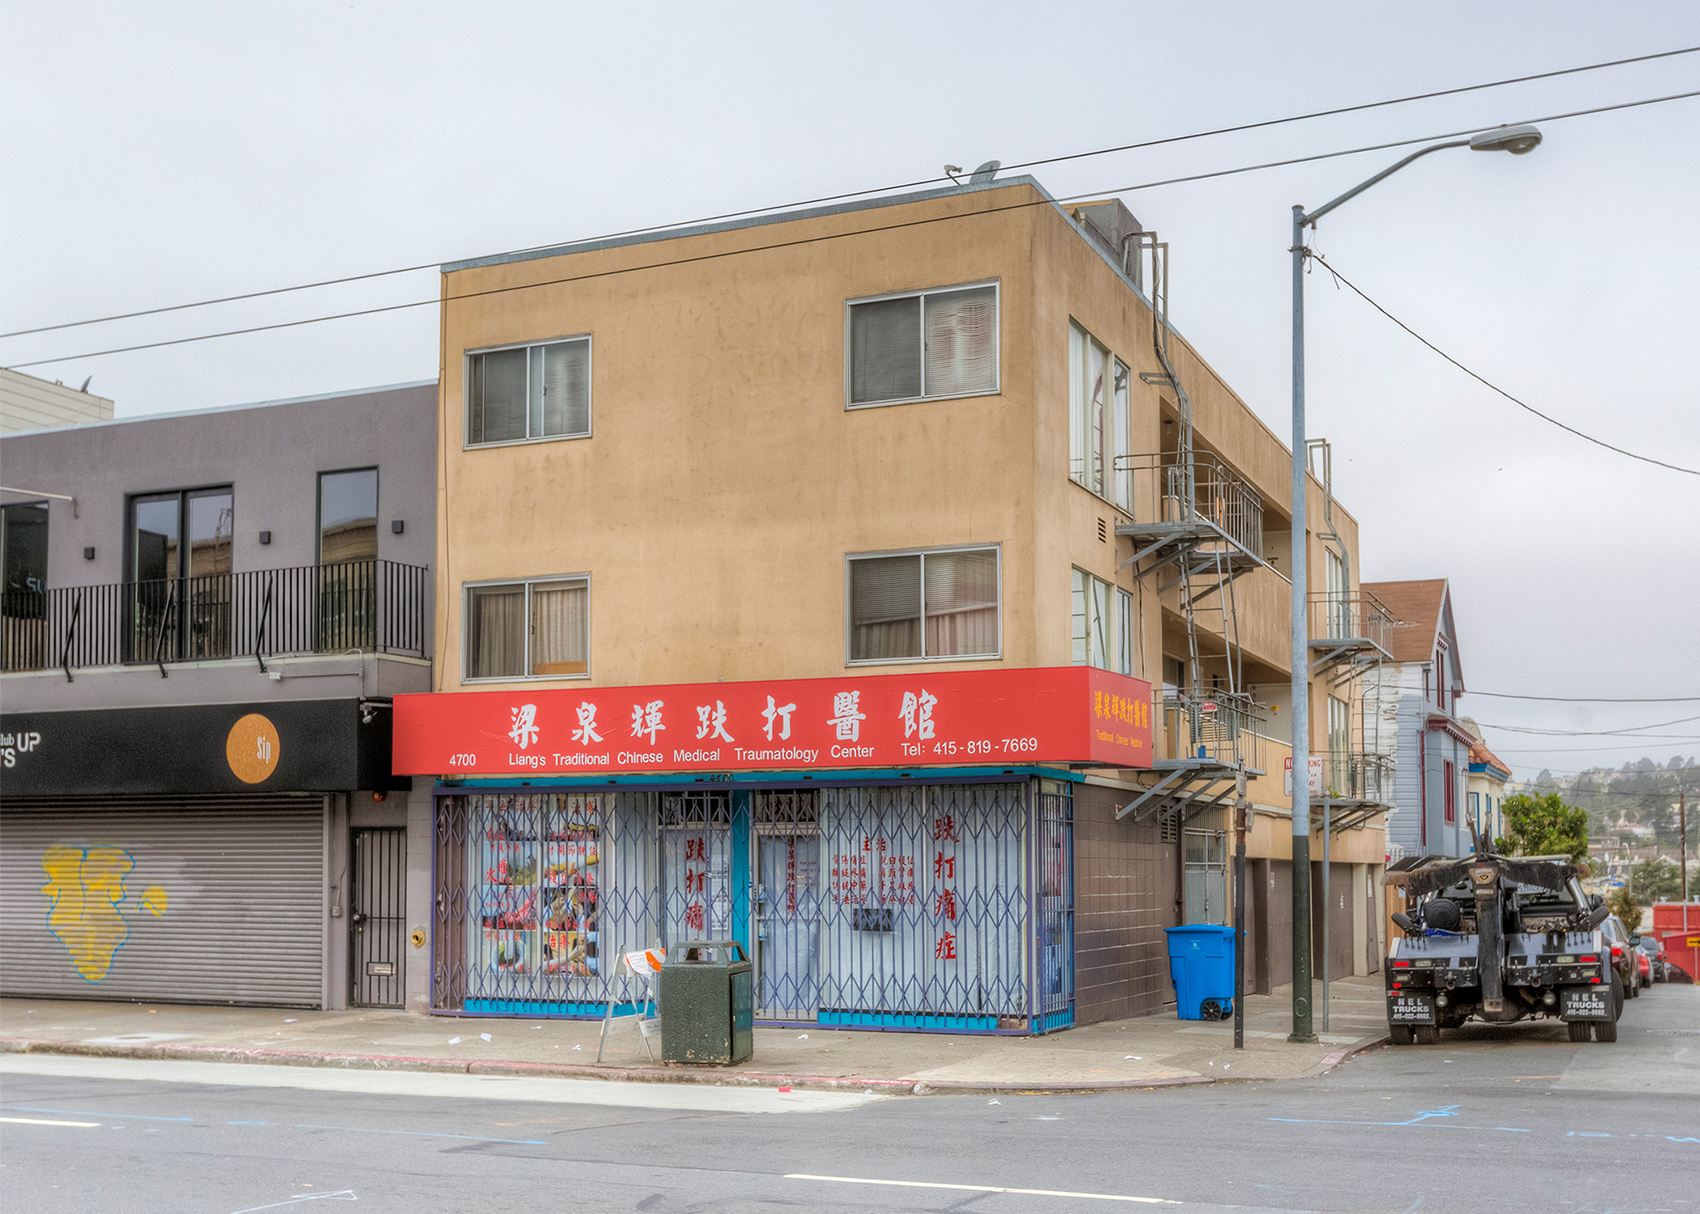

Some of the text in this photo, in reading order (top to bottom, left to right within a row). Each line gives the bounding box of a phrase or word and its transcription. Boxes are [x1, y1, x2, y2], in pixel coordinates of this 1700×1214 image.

[0, 731, 41, 752] lub UP
[257, 736, 271, 764] Sip
[449, 753, 476, 767] 4700
[509, 752, 546, 769] Liang's
[552, 752, 610, 766] Traditional
[617, 750, 664, 764] Chinese
[673, 748, 721, 763] Medical
[734, 746, 819, 763] Traumatology
[830, 744, 875, 759] Center
[901, 742, 926, 757] Tel:
[862, 836, 887, 851] 主治
[685, 837, 706, 956] 跌打痛
[934, 813, 960, 960] 跌打痛症
[1566, 1001, 1605, 1009] TRUCKS
